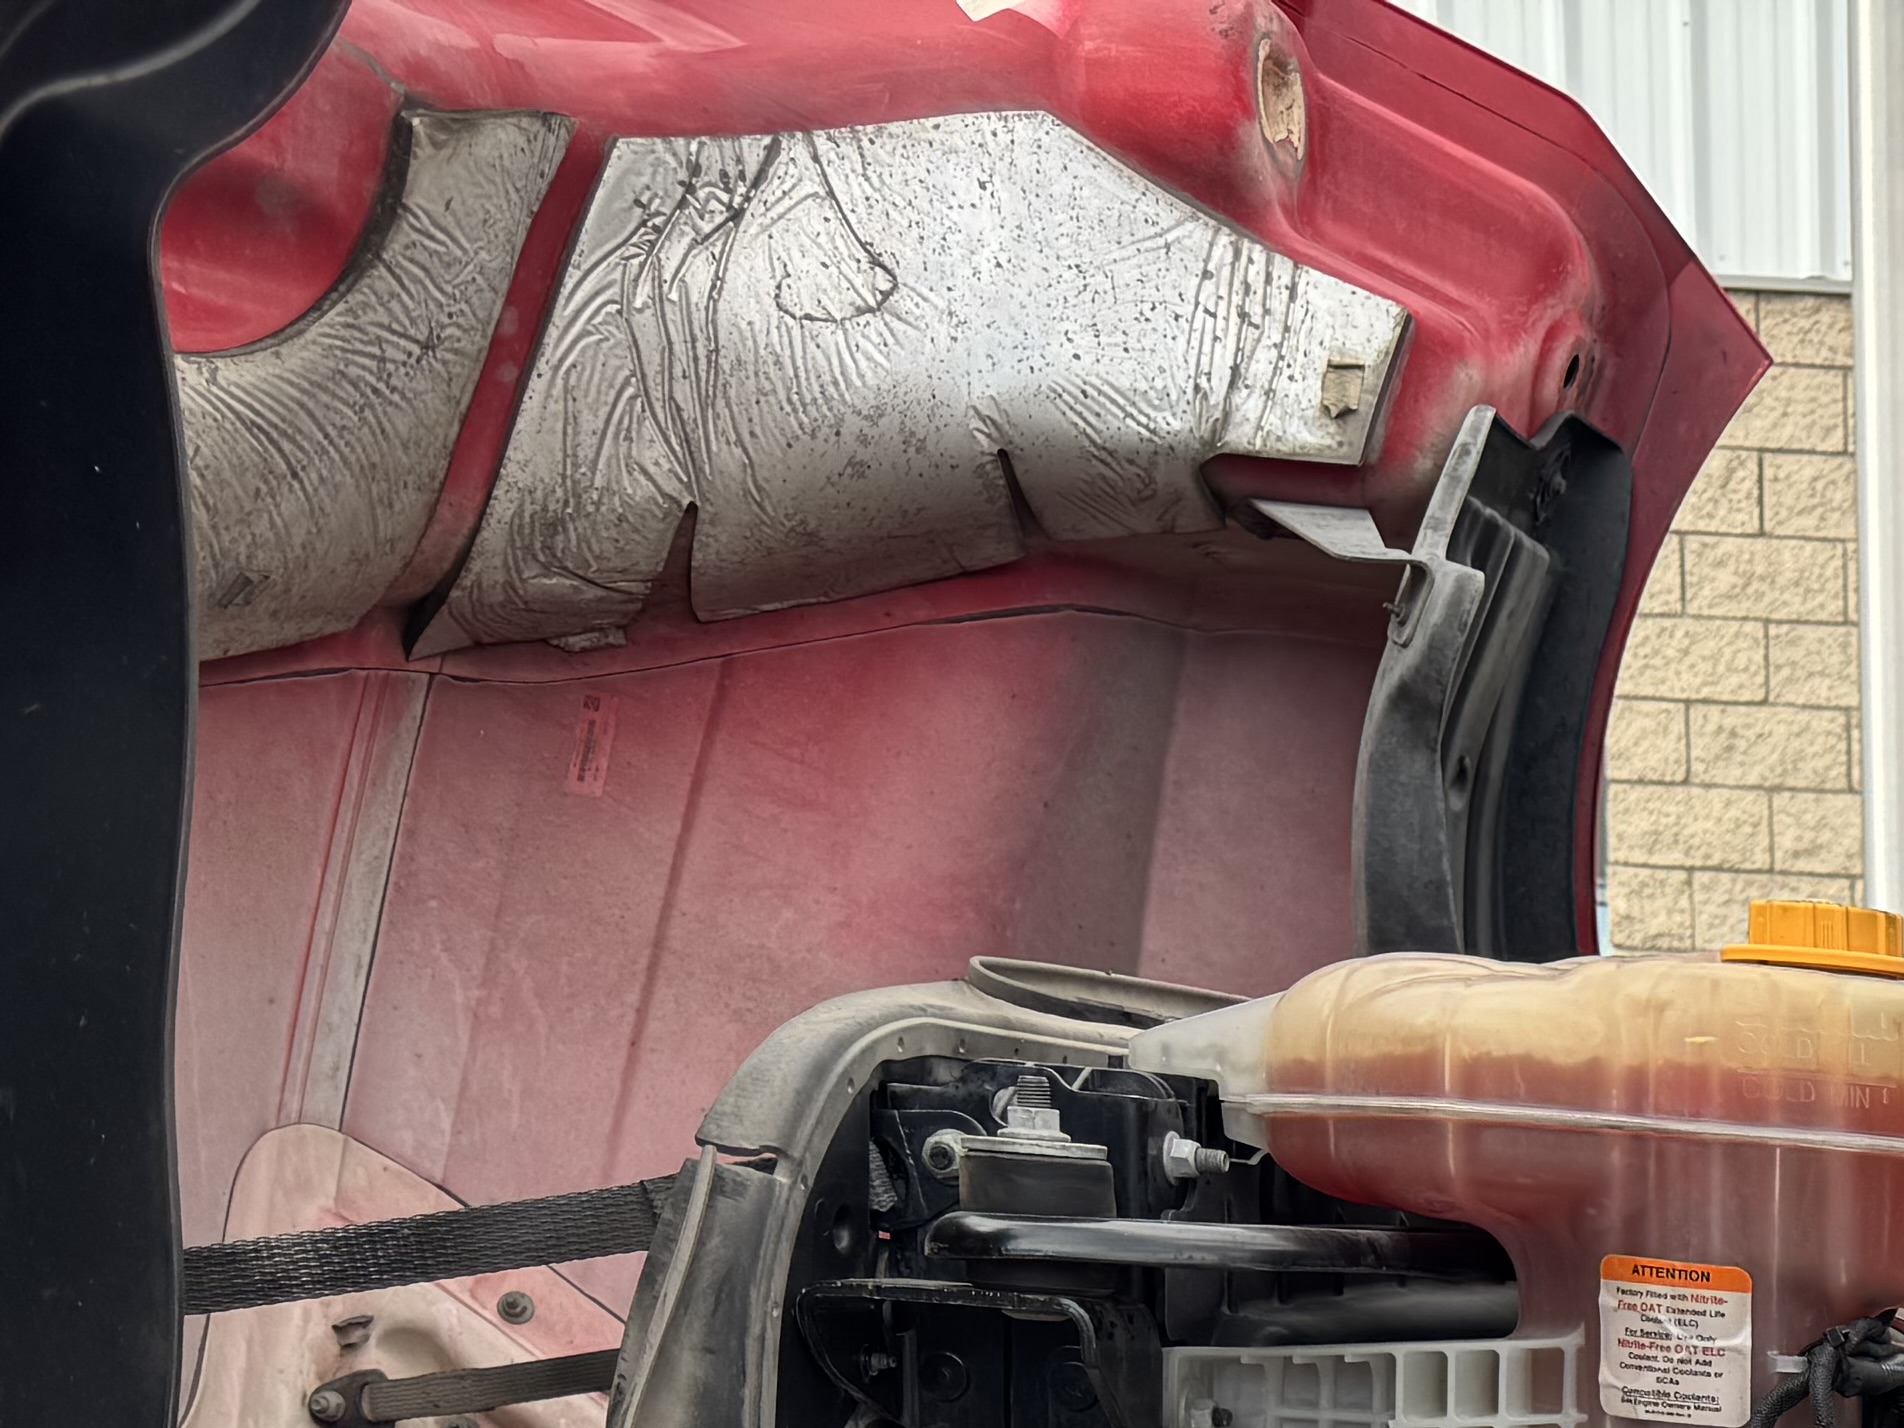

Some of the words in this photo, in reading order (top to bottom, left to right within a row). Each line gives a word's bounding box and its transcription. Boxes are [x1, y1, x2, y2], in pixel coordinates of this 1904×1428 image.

[1631, 1264, 1711, 1283] ATTENTION
[1616, 1287, 1643, 1299] Factory
[1646, 1290, 1668, 1301] Filled
[1670, 1292, 1689, 1302] with
[1690, 1294, 1728, 1306] Nitrite-
[1617, 1300, 1638, 1312] Free
[1640, 1302, 1662, 1314] OAT
[1666, 1306, 1707, 1317] Extended
[1709, 1310, 1726, 1318] Life
[1674, 1318, 1699, 1330] (ELC)
[1625, 1327, 1638, 1337] For
[1696, 1334, 1717, 1343] Only
[1617, 1338, 1671, 1353] Nitrite-Free
[1674, 1343, 1699, 1355] OAT
[1702, 1347, 1726, 1357] ELC
[1663, 1355, 1674, 1363] Do
[1677, 1357, 1692, 1366] Not
[1695, 1359, 1712, 1367] Add
[1619, 1362, 1670, 1374] Conventional
[1673, 1367, 1711, 1378] Coolants
[1621, 1386, 1671, 1399] Compatible
[1693, 1403, 1722, 1412] Manual
